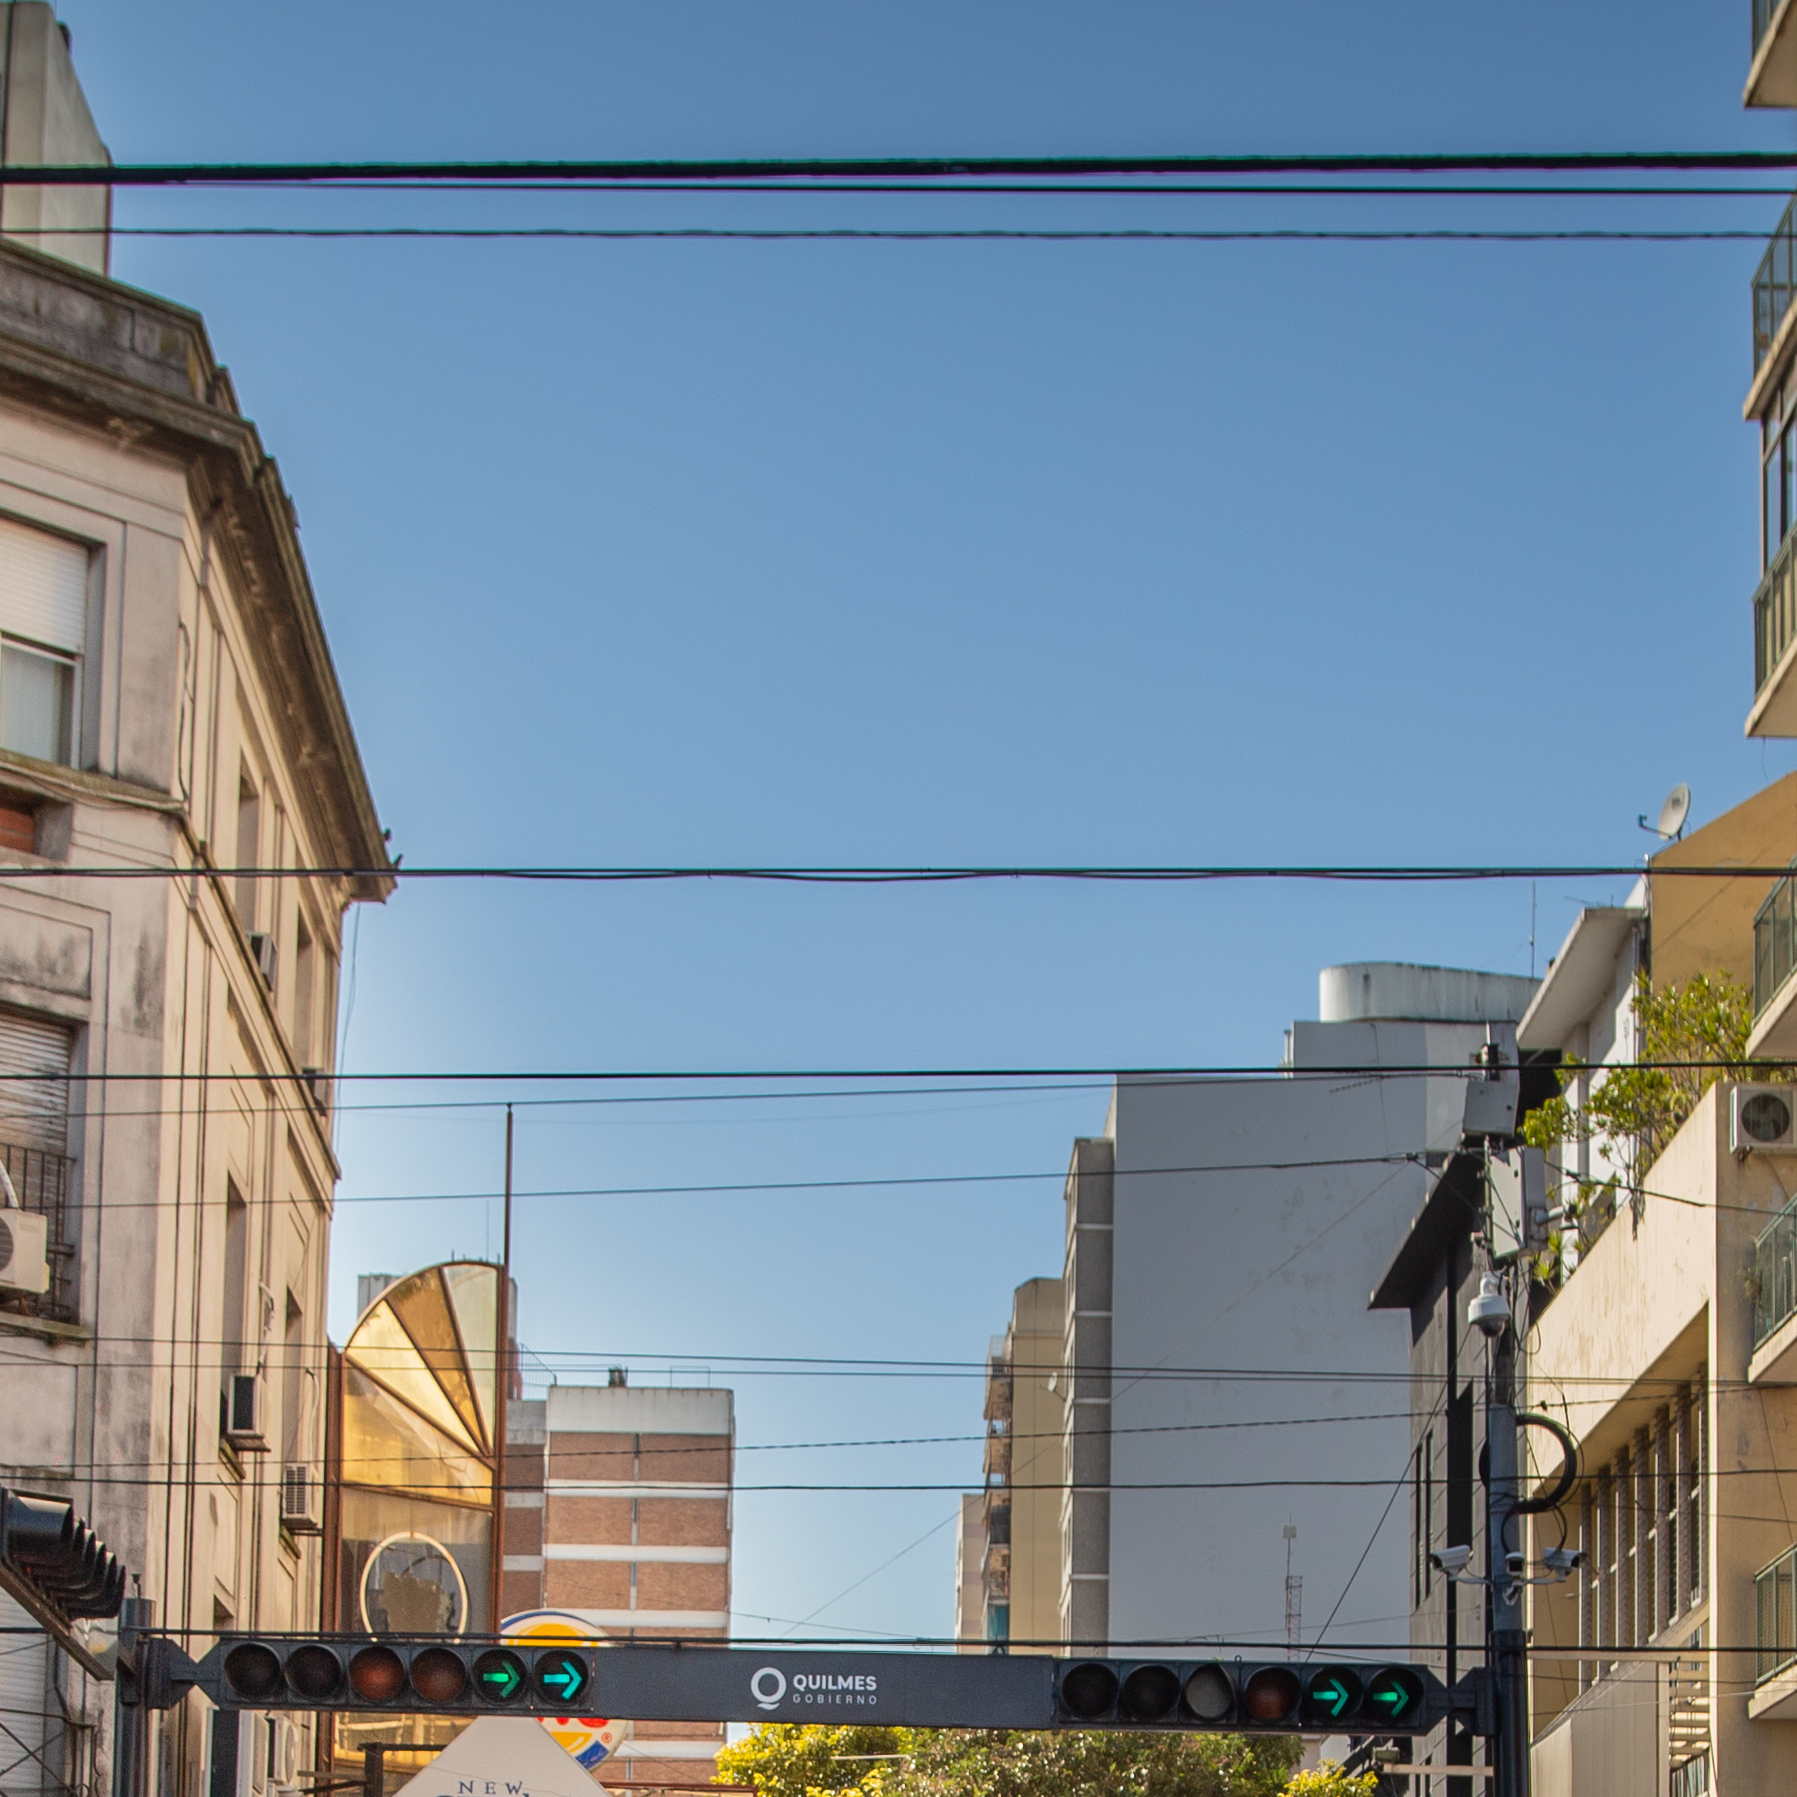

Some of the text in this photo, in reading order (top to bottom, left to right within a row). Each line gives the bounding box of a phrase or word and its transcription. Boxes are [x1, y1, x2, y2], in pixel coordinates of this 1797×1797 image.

[792, 1673, 878, 1692] QUILMES
[792, 1693, 878, 1705] GOBIERNO
[458, 1779, 523, 1795] NEW
